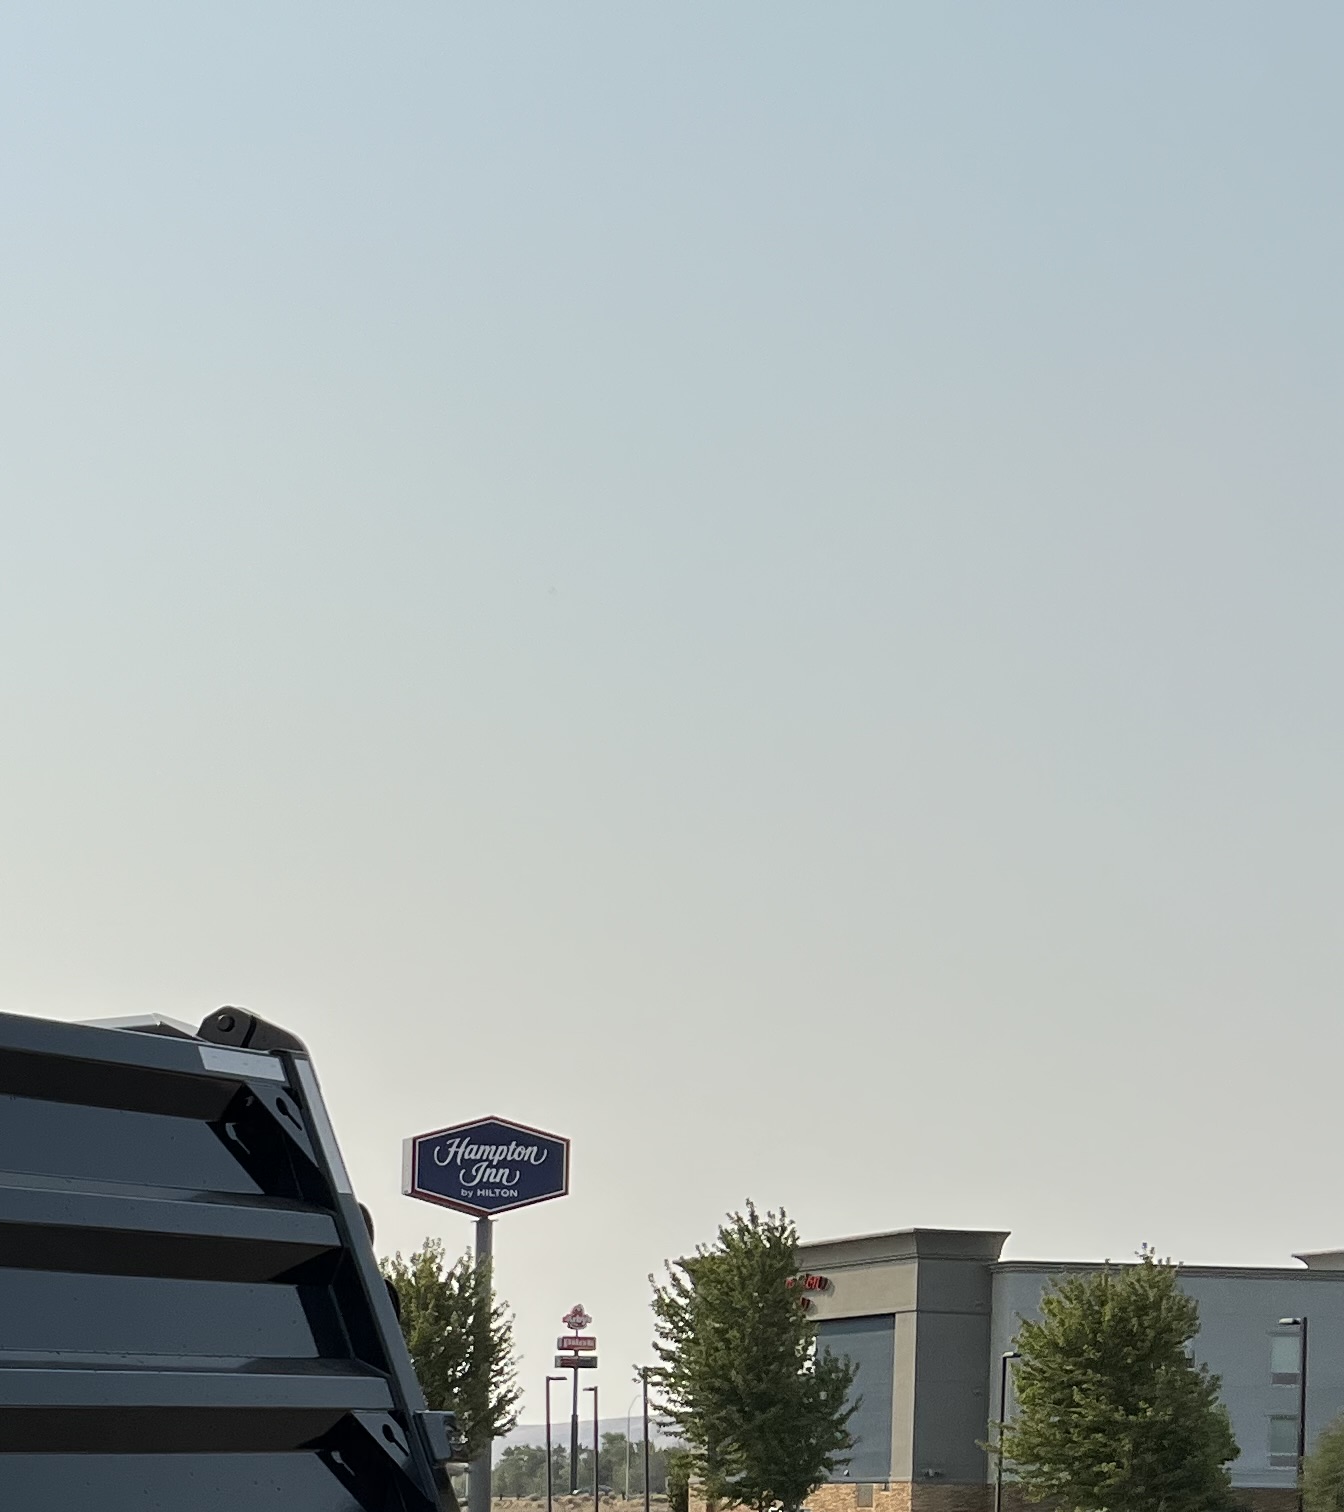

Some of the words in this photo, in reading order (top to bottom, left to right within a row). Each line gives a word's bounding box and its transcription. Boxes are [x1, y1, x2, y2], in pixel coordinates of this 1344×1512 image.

[433, 1136, 548, 1166] Hampton
[459, 1161, 520, 1187] Inn
[461, 1188, 474, 1198] by
[476, 1188, 519, 1198] HILTON
